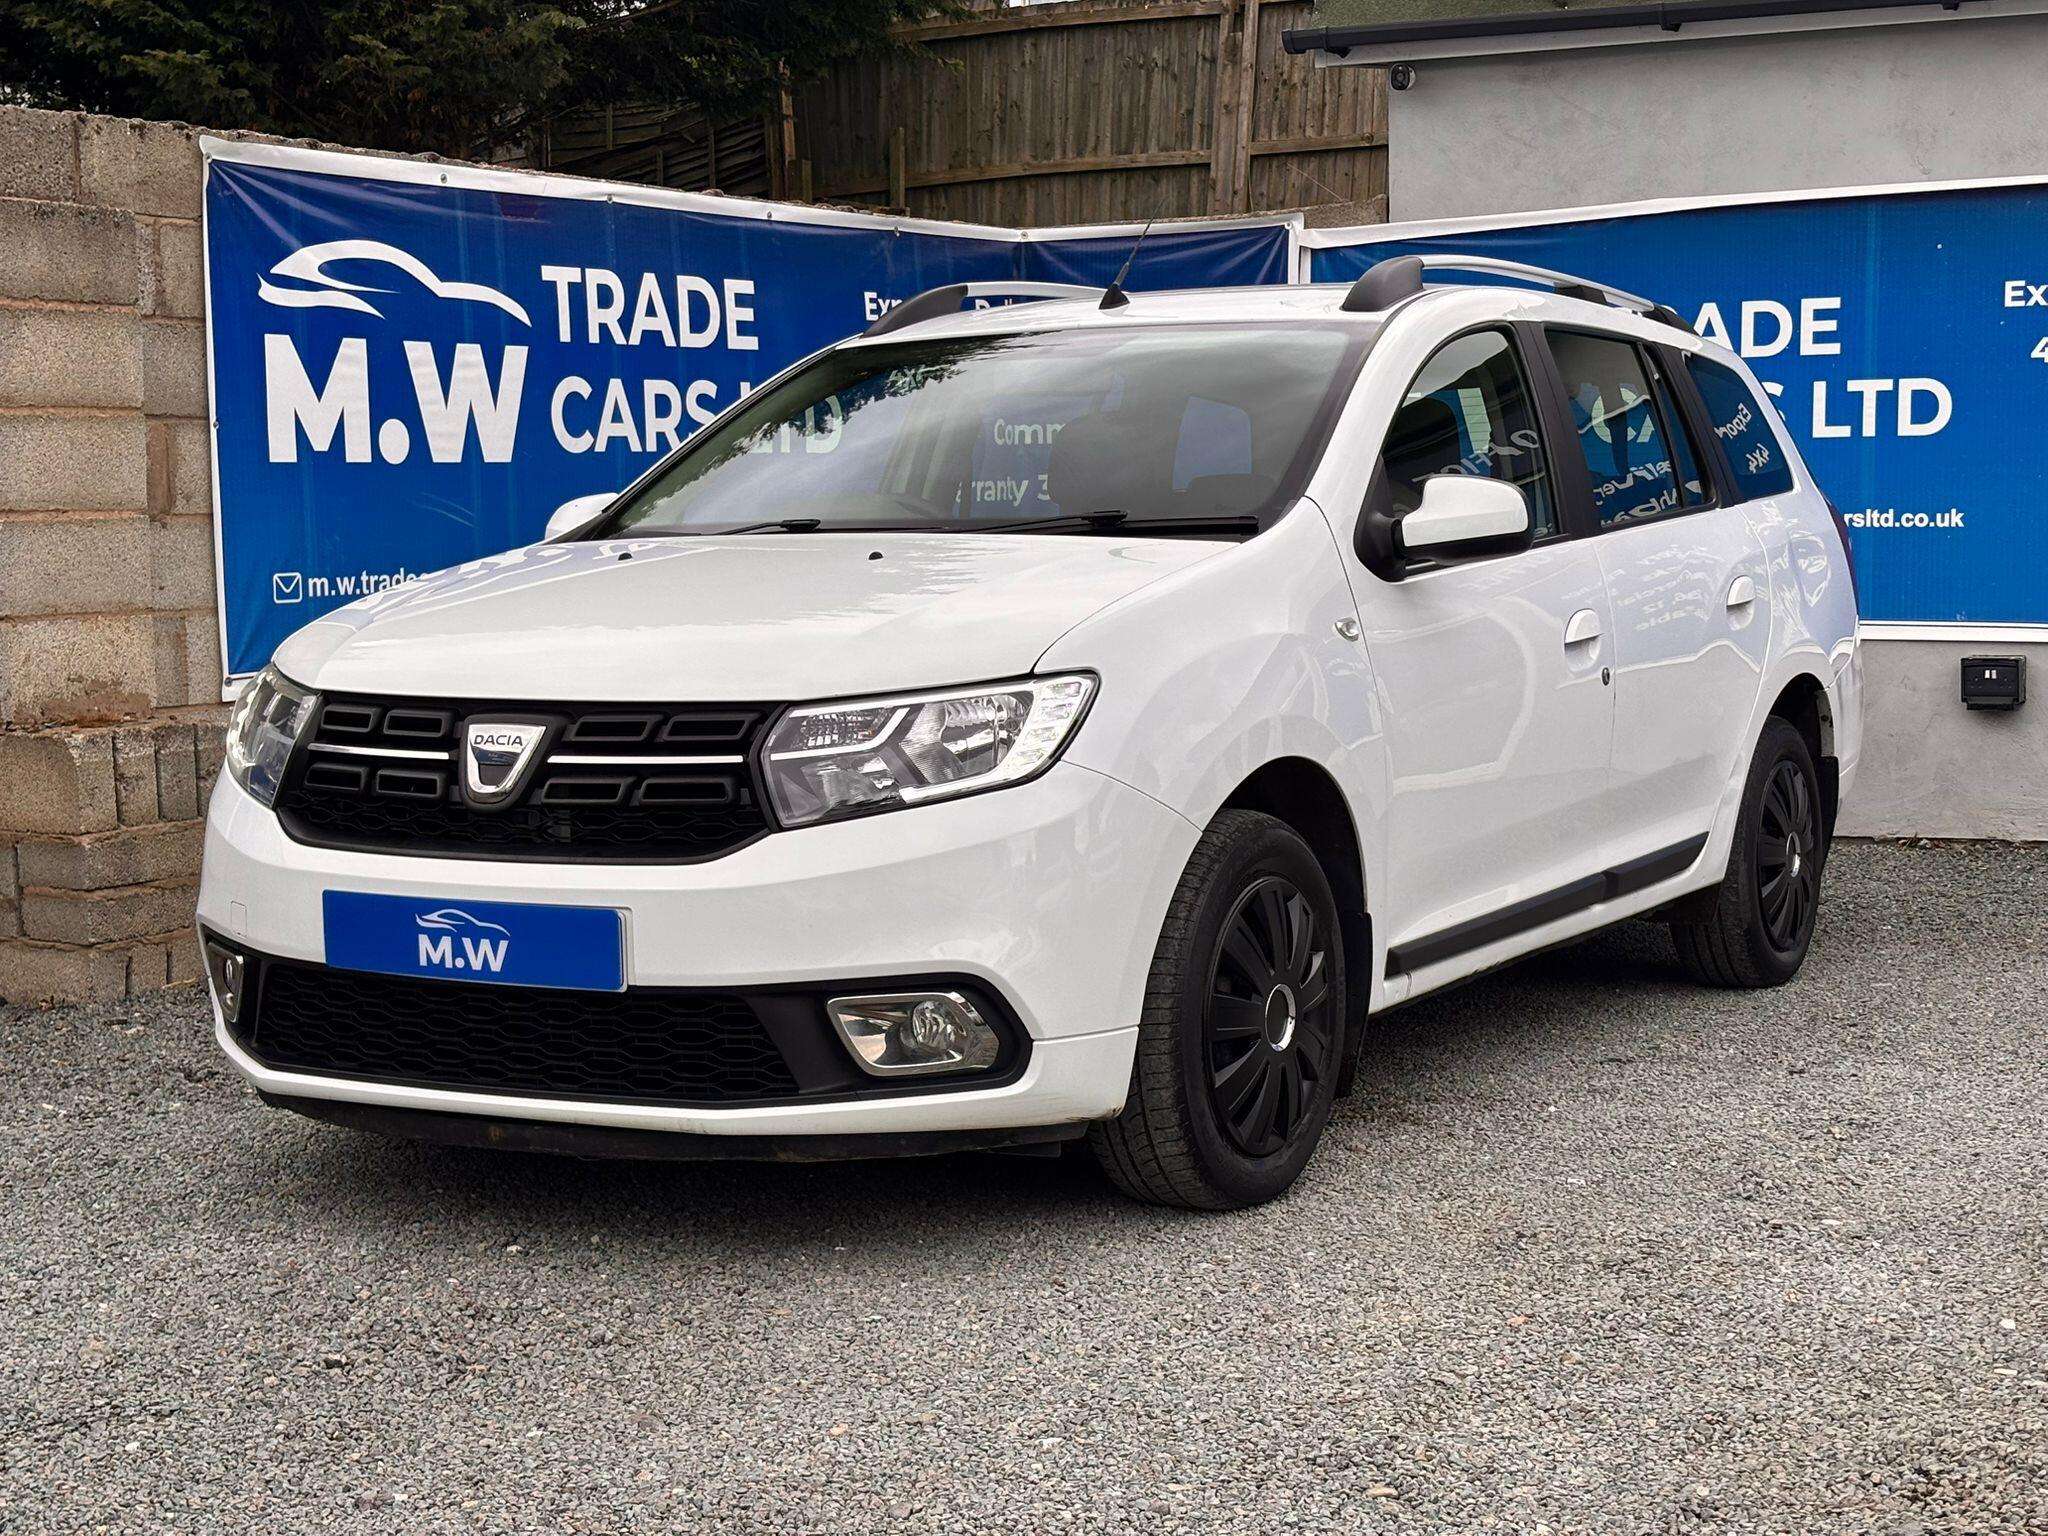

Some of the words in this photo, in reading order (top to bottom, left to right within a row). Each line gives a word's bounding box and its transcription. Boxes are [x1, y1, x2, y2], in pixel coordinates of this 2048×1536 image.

[541, 265, 759, 350] TRADE
[1661, 297, 1841, 358] ADE
[265, 334, 529, 464] M.W
[1812, 378, 1952, 438] LTD
[308, 568, 430, 598] m.w.trad
[474, 734, 524, 746] DACIA
[418, 934, 509, 972] M.W
